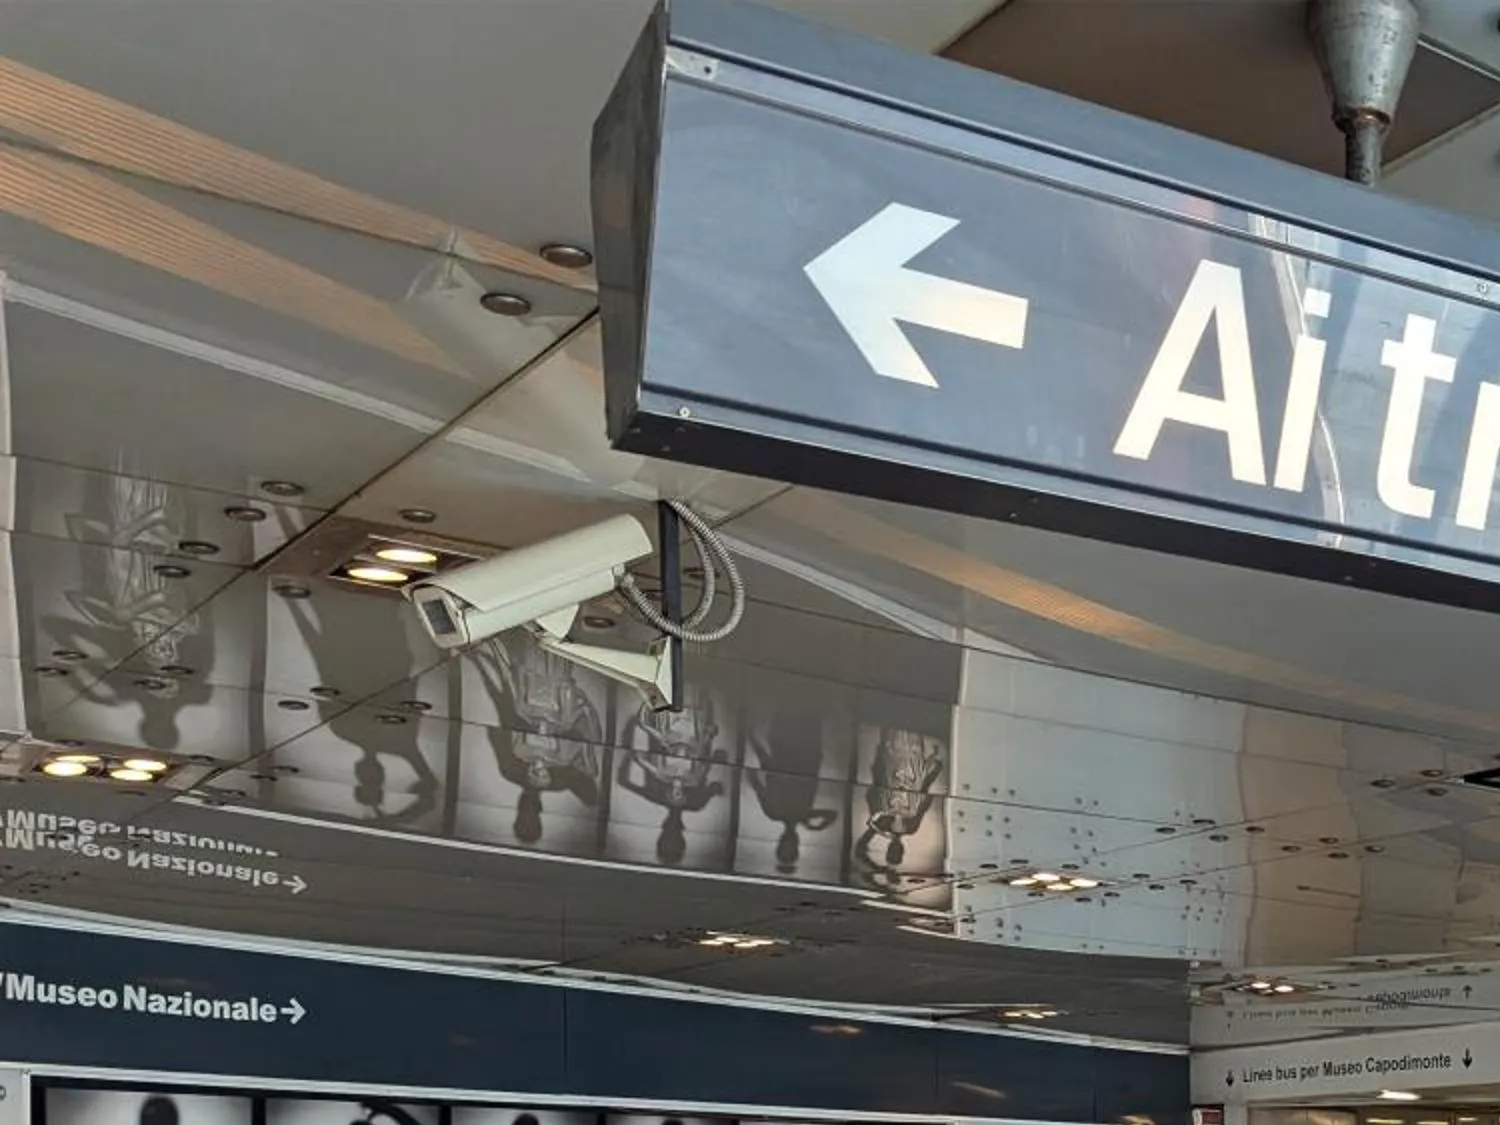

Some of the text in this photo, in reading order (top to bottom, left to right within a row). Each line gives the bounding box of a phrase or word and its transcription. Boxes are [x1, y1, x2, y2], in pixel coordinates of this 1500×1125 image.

[1113, 258, 1330, 494] Ai
[123, 984, 278, 1023] Nazionale
[1275, 1064, 1298, 1081] bus
[1300, 1065, 1320, 1081] per
[1322, 1060, 1363, 1079] Museo
[1365, 1053, 1452, 1076] Capodimonte
